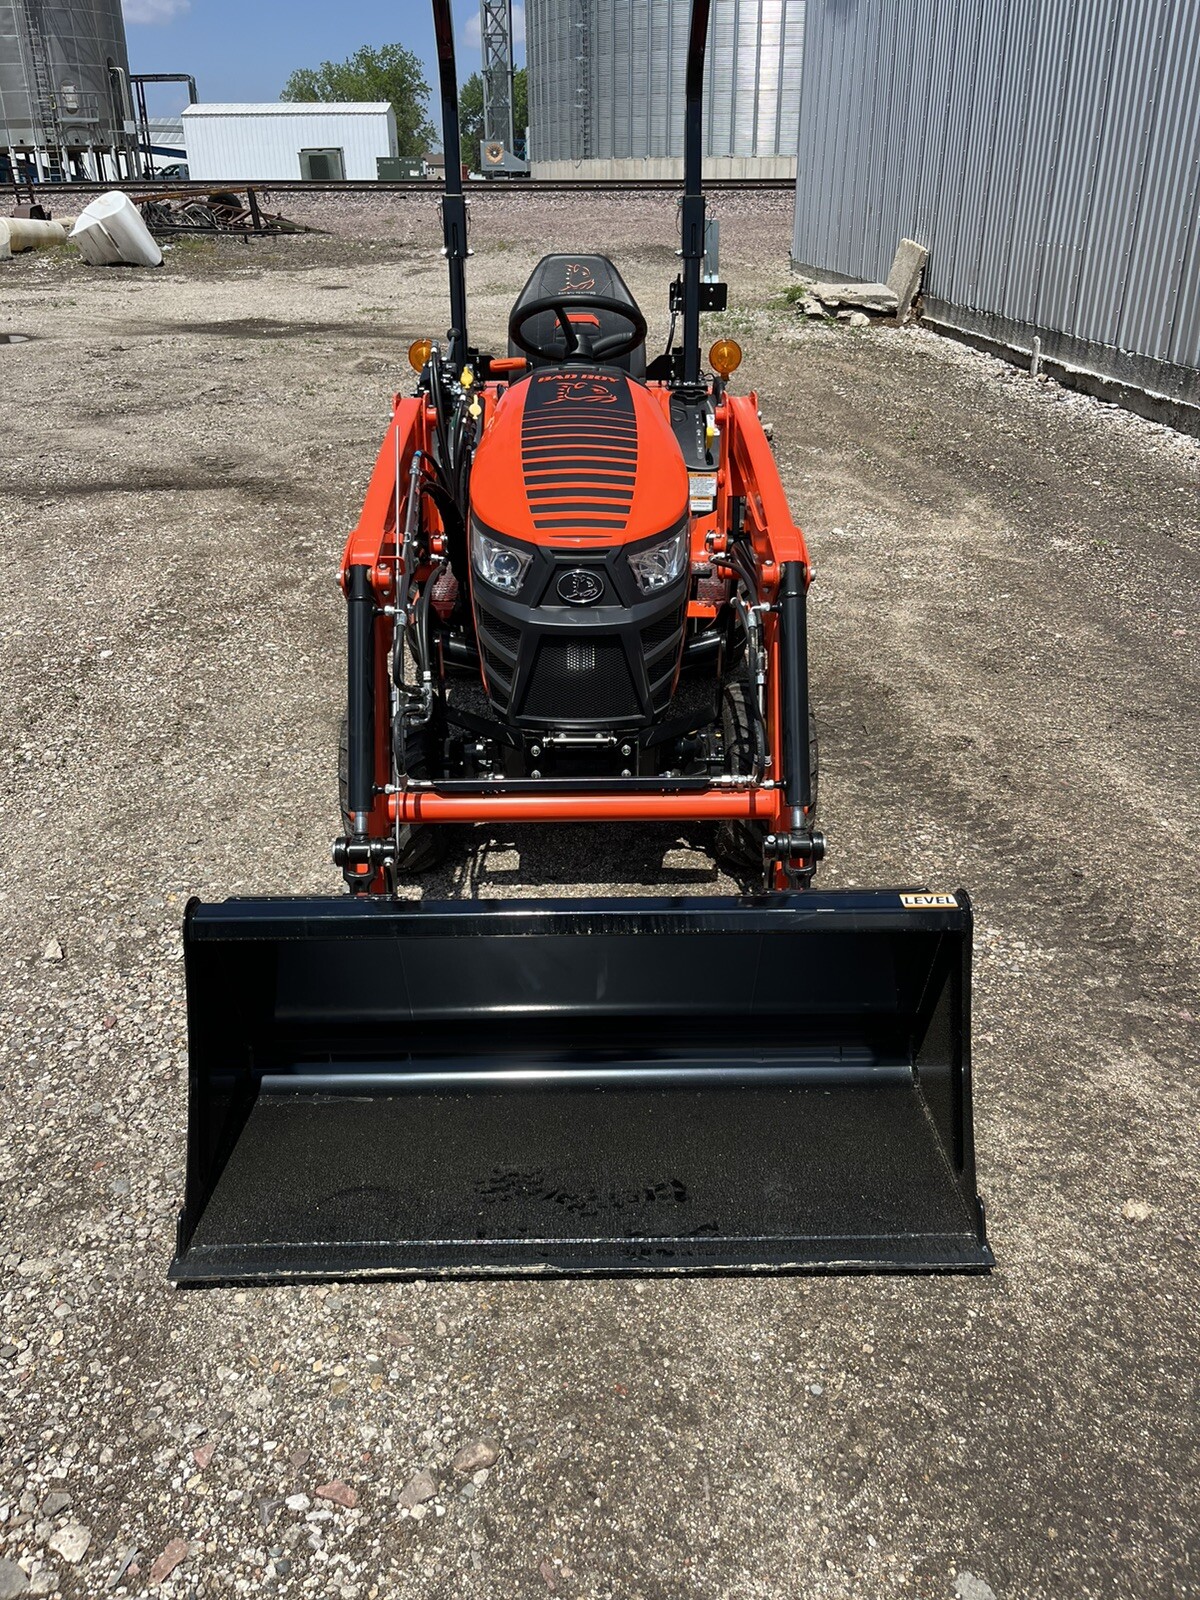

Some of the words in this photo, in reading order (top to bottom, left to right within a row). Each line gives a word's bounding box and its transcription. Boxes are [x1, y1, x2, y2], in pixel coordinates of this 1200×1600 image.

[537, 374, 578, 383] BAD
[581, 374, 619, 383] BOY
[904, 896, 955, 905] LEVEL
